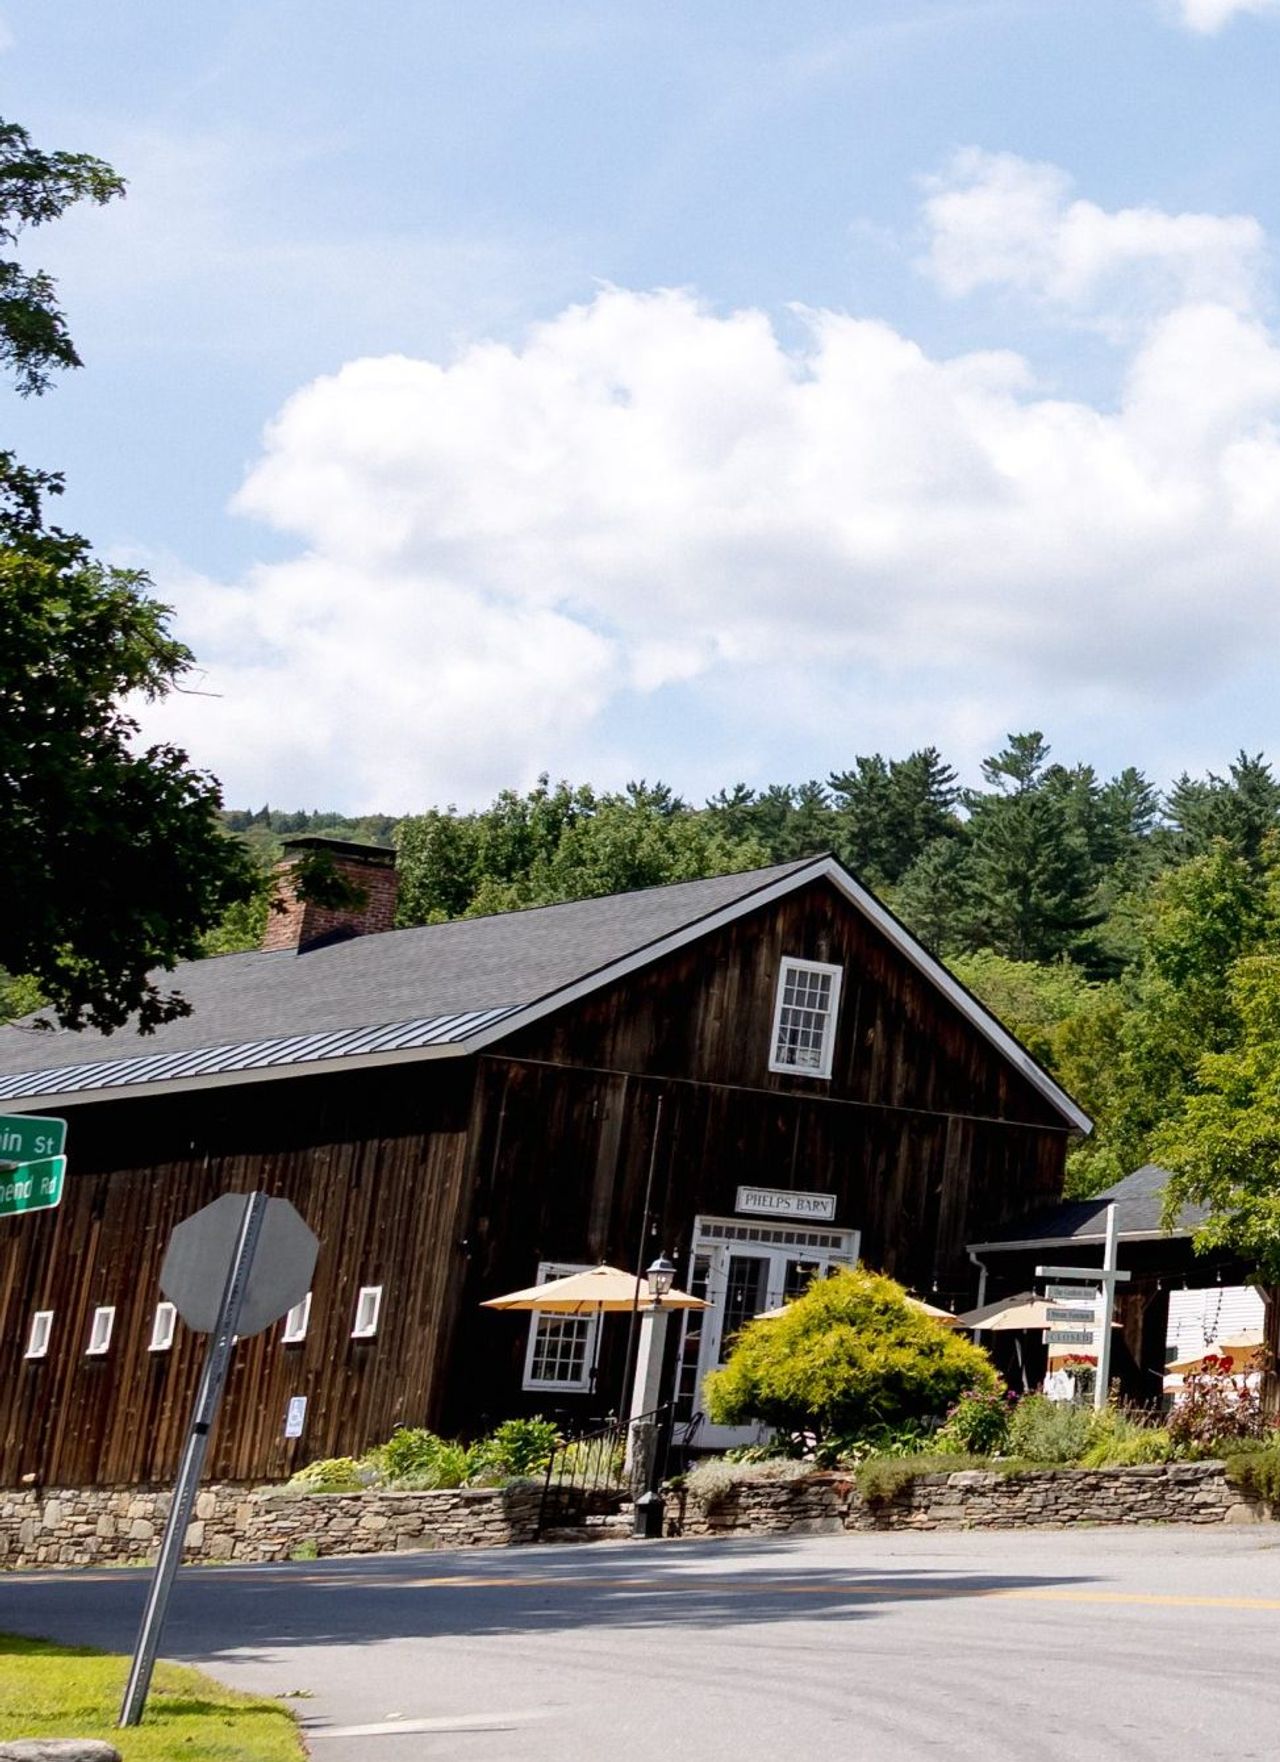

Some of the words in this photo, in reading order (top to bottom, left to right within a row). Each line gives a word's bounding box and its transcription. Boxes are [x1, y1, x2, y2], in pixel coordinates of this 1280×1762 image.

[0, 1127, 22, 1152] in
[34, 1135, 54, 1154] St
[40, 1176, 57, 1195] Rd
[745, 1193, 791, 1209] PHELPS
[796, 1199, 829, 1212] BARN
